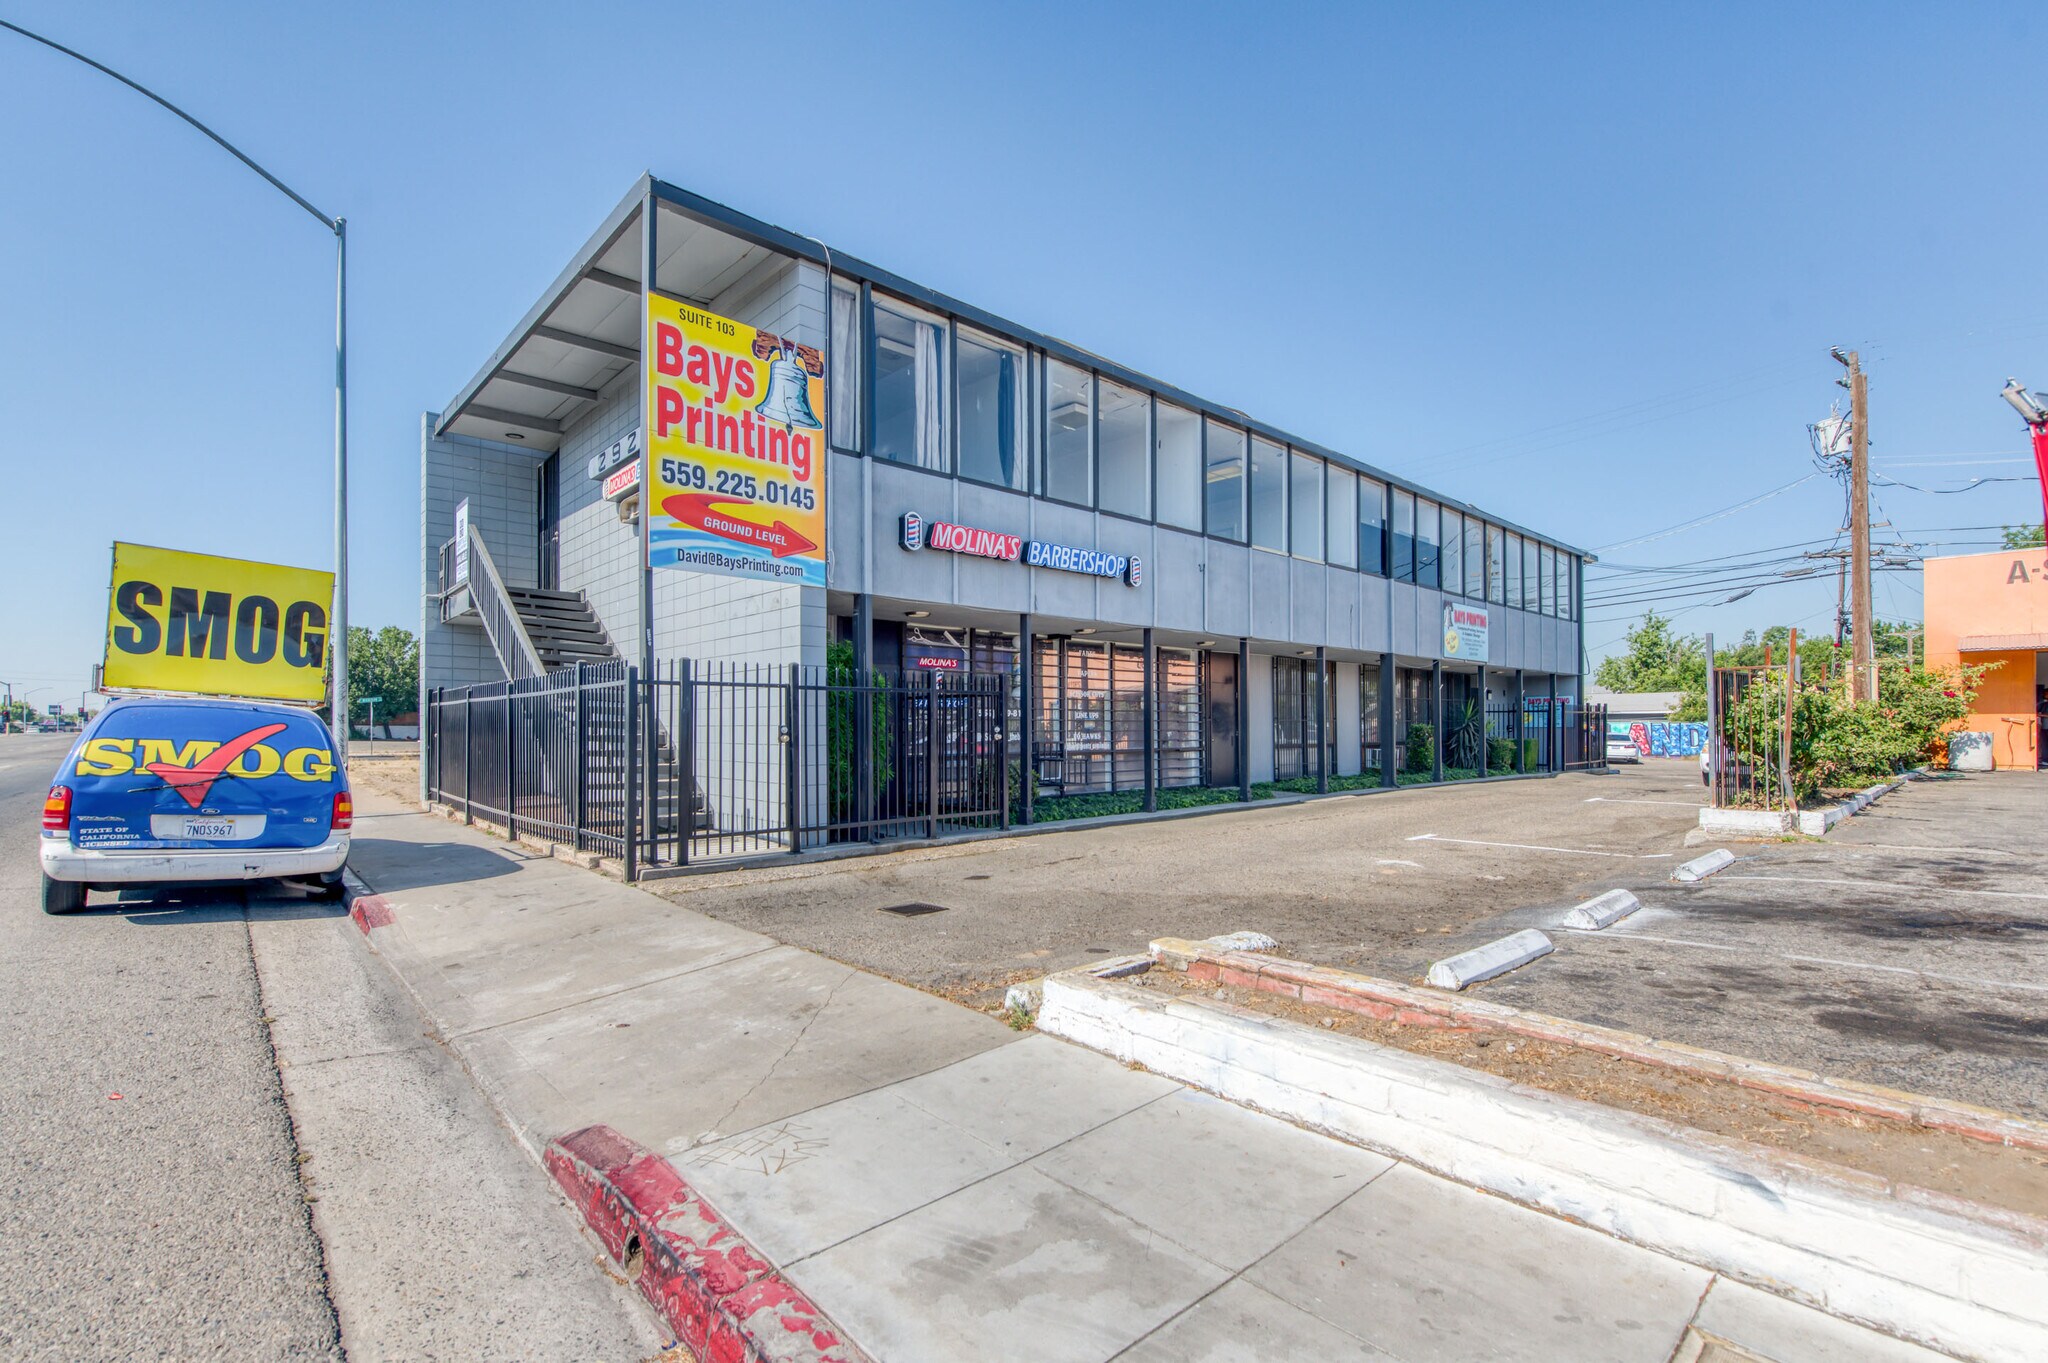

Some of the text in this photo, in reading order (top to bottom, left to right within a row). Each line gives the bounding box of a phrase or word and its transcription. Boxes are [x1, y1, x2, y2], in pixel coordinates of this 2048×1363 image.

[679, 308, 735, 337] SUITE 103
[657, 321, 755, 404] Bays
[657, 384, 811, 482] Printing
[662, 458, 815, 511] 559.225.0145
[704, 516, 787, 546] GROUND LEVEL
[932, 522, 1126, 578] MOLINA'S BARBERSHOP
[677, 548, 804, 577] David@BaysPrinting.com
[114, 580, 326, 668] SMOG
[919, 657, 958, 668] MOLINA'S
[75, 737, 338, 783] SMOG
[80, 840, 130, 848] LICENSED
[186, 825, 233, 836] 7NOS967
